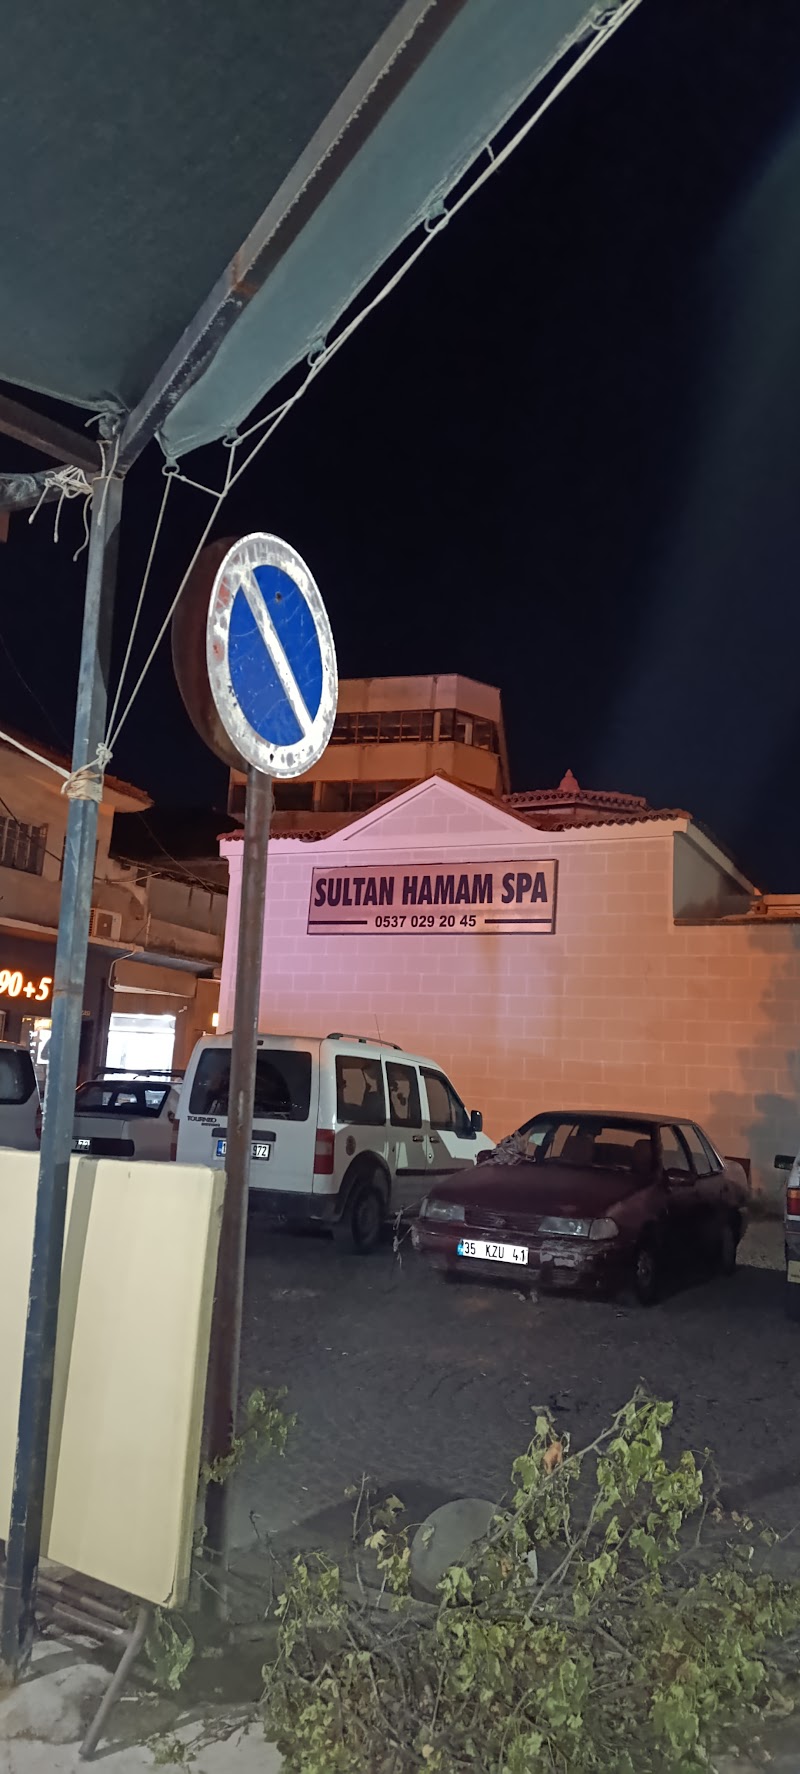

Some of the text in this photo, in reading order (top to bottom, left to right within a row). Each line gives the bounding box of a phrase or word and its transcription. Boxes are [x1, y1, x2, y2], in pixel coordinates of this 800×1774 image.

[314, 872, 548, 907] SULTAN HAMAM SPA
[375, 915, 477, 928] 0537 029 20 45
[464, 1241, 526, 1262] 35 KZU 41
